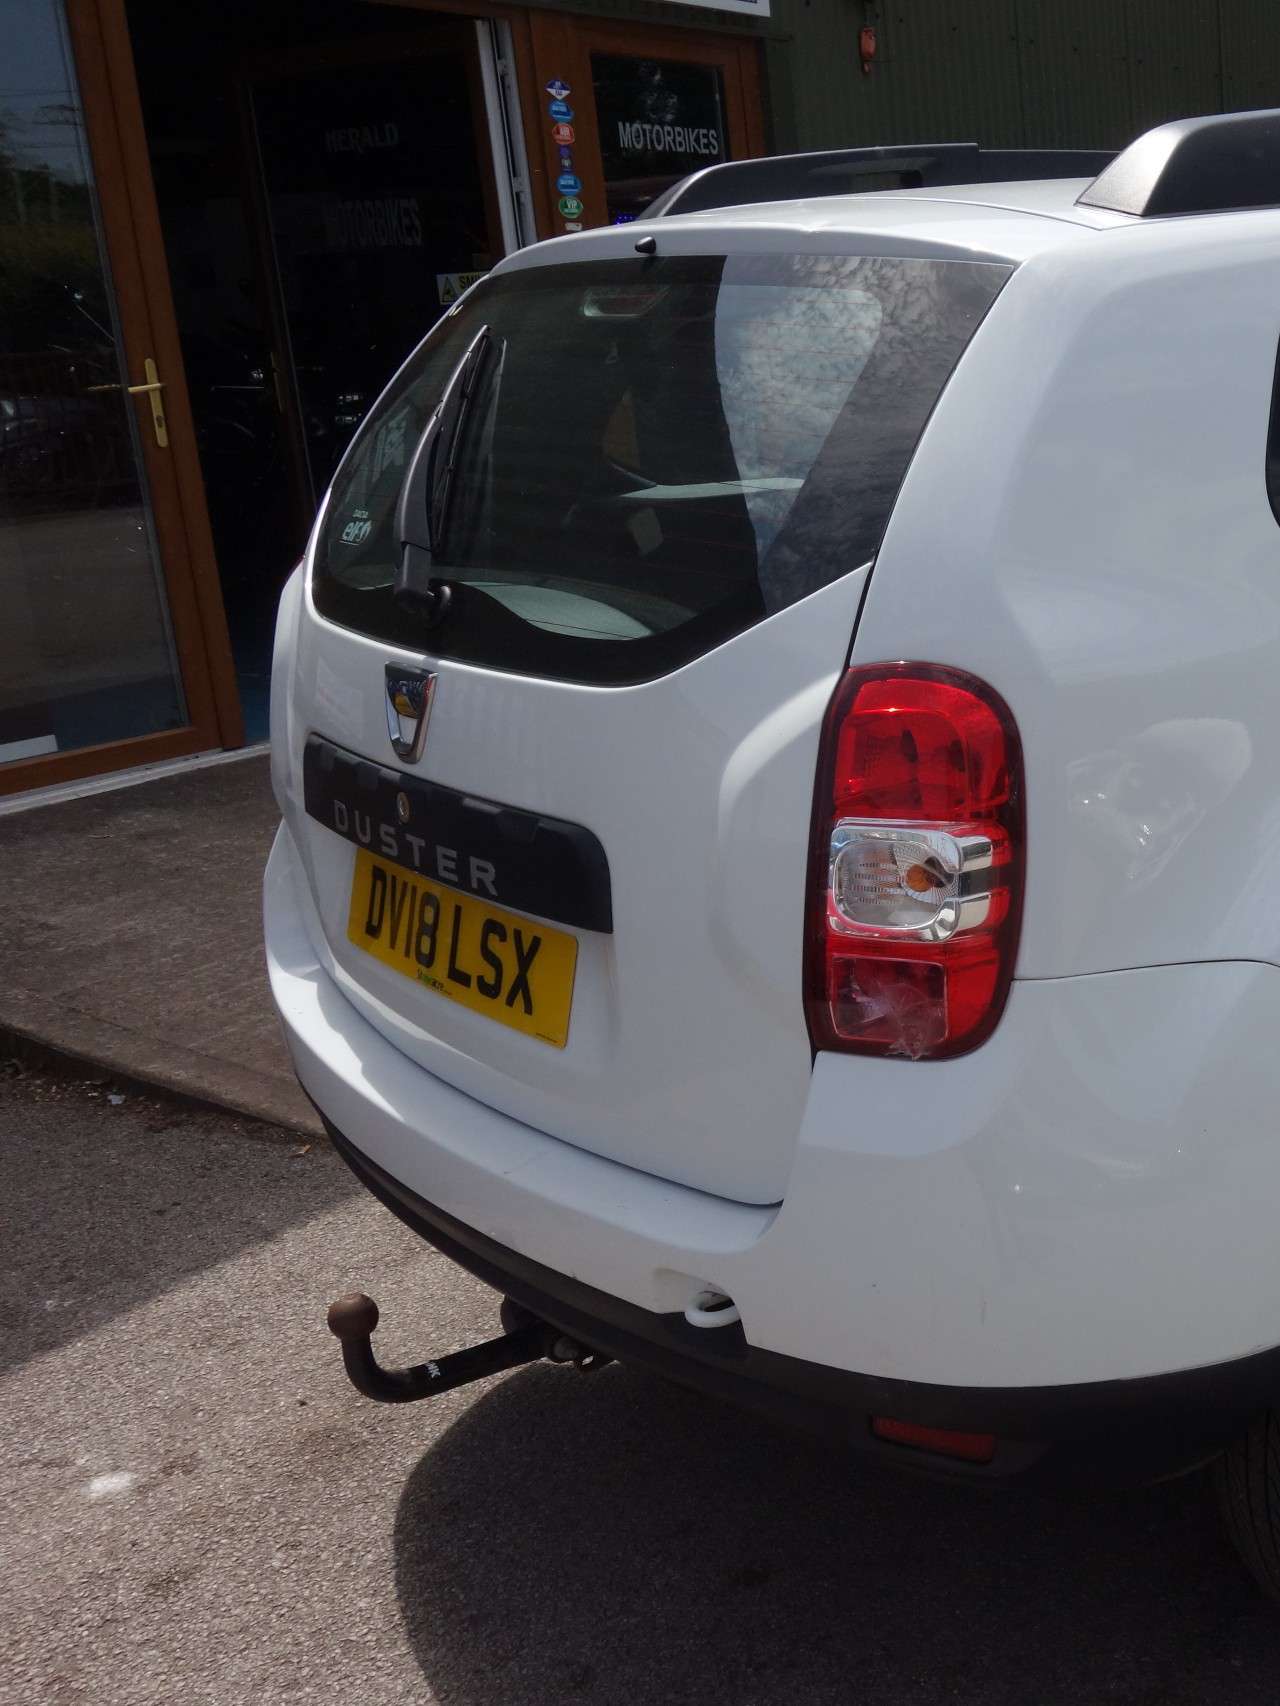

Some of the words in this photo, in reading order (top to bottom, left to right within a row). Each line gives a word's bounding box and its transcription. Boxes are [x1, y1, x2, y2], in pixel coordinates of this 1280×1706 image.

[618, 121, 719, 155] MOTORBIKES
[334, 800, 498, 896] DUSTER
[365, 864, 440, 969] DV18
[447, 904, 542, 1015] LSX
